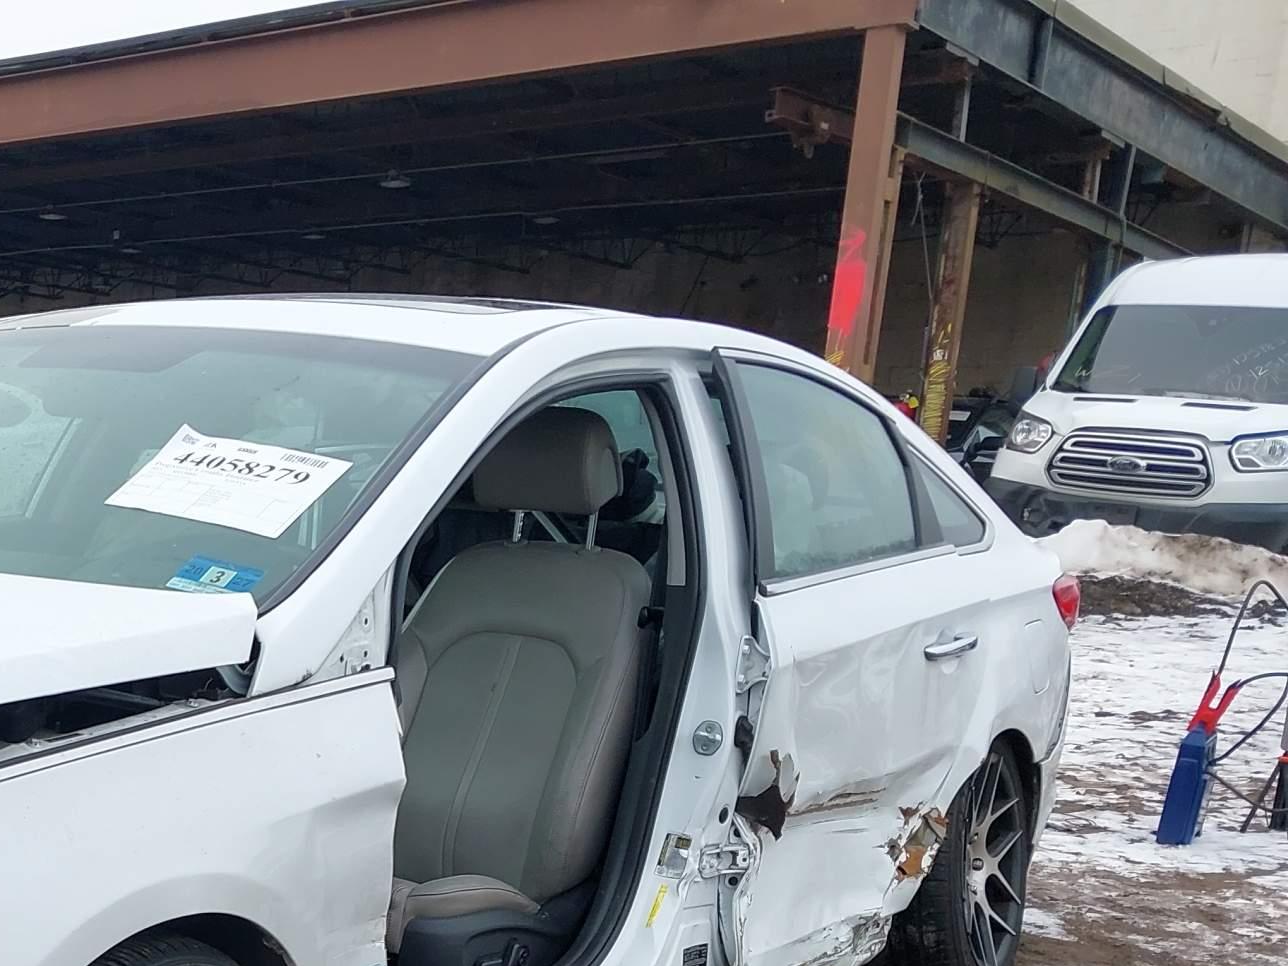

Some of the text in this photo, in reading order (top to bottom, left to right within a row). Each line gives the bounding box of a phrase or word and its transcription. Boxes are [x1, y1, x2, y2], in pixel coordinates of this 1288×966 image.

[173, 451, 311, 485] 44058279
[185, 564, 204, 576] 20
[210, 570, 226, 584] 3
